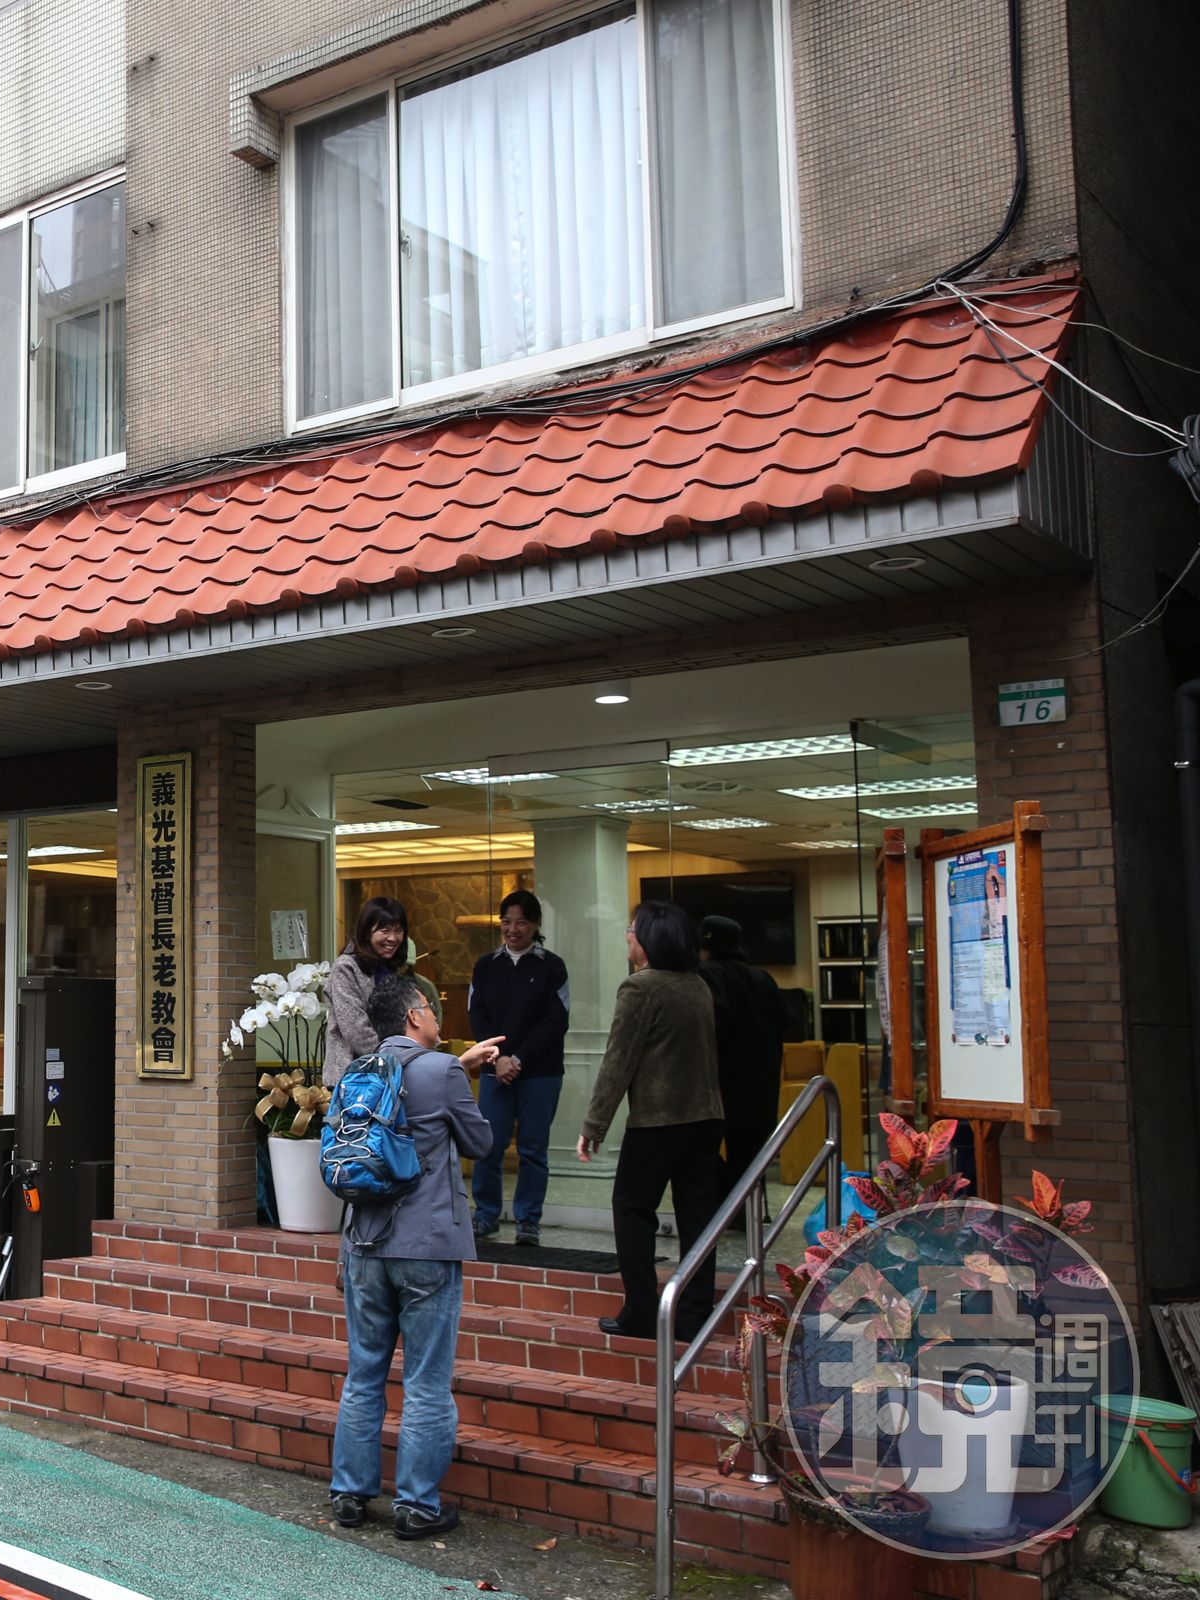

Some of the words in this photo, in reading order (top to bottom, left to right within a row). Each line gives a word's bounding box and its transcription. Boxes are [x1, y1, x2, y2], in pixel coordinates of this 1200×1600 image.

[1016, 700, 1051, 722] 16
[150, 772, 177, 1063] 義光基督長老教會
